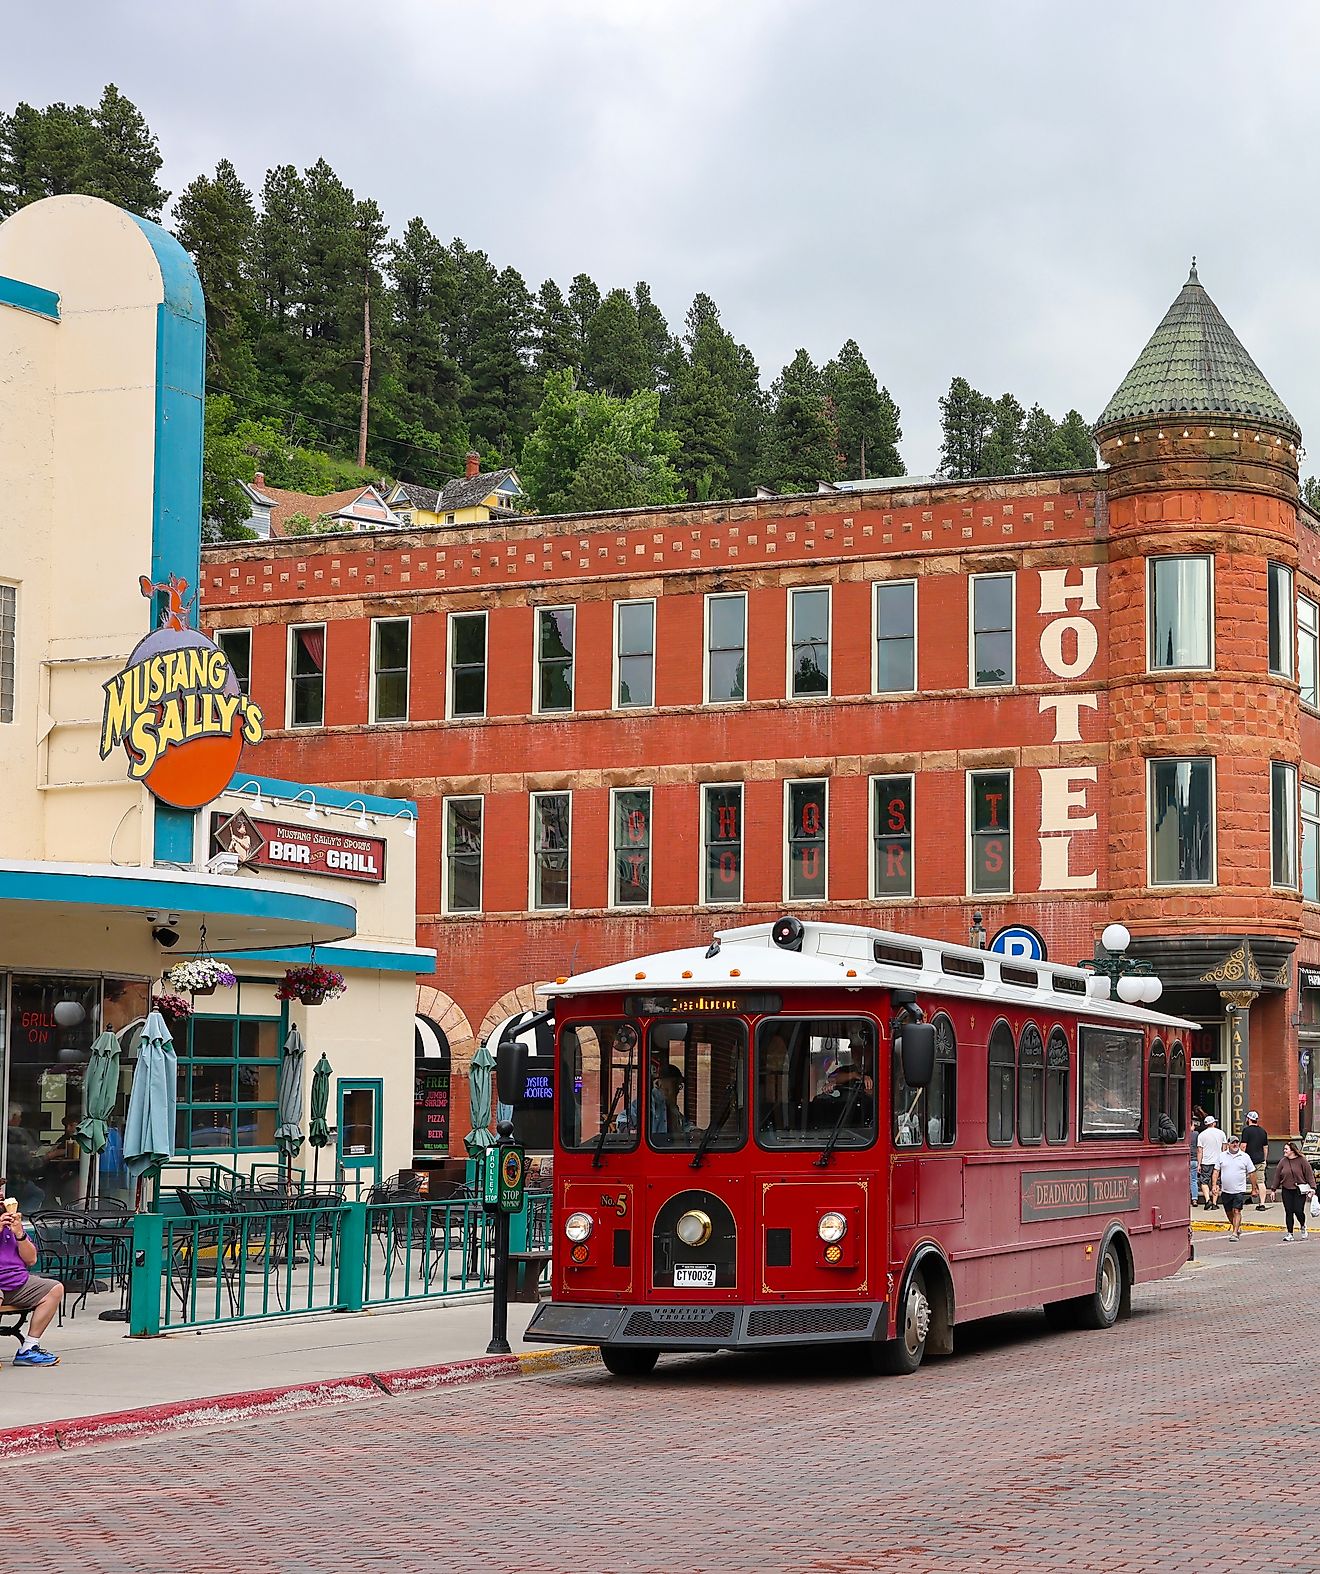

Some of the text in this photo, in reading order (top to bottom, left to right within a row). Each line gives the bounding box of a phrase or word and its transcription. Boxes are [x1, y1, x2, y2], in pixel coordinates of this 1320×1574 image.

[102, 648, 228, 755] MUSTANG
[131, 692, 264, 778] SALLY'S
[1037, 566, 1101, 891] HOTEL
[628, 793, 1003, 843] GHOST
[277, 827, 371, 852] MUSTANG SALLY'S SPORTS
[269, 841, 378, 874] BAR AND GRILL
[627, 839, 1004, 889] TOURS
[22, 1012, 57, 1028] GRILL
[28, 1029, 48, 1043] ON
[426, 1076, 449, 1088] FREE
[424, 1099, 448, 1107] SHRIMP
[427, 1091, 447, 1099] JUMBO
[427, 1114, 446, 1123] PIZZA
[1231, 1081, 1243, 1135] HOTE
[427, 1130, 444, 1139] BEER
[485, 1194, 498, 1202] STOP
[503, 1190, 520, 1200] STOP
[1036, 1179, 1129, 1205] DEADWOOD TROLLEY
[601, 1194, 627, 1216] No. 5
